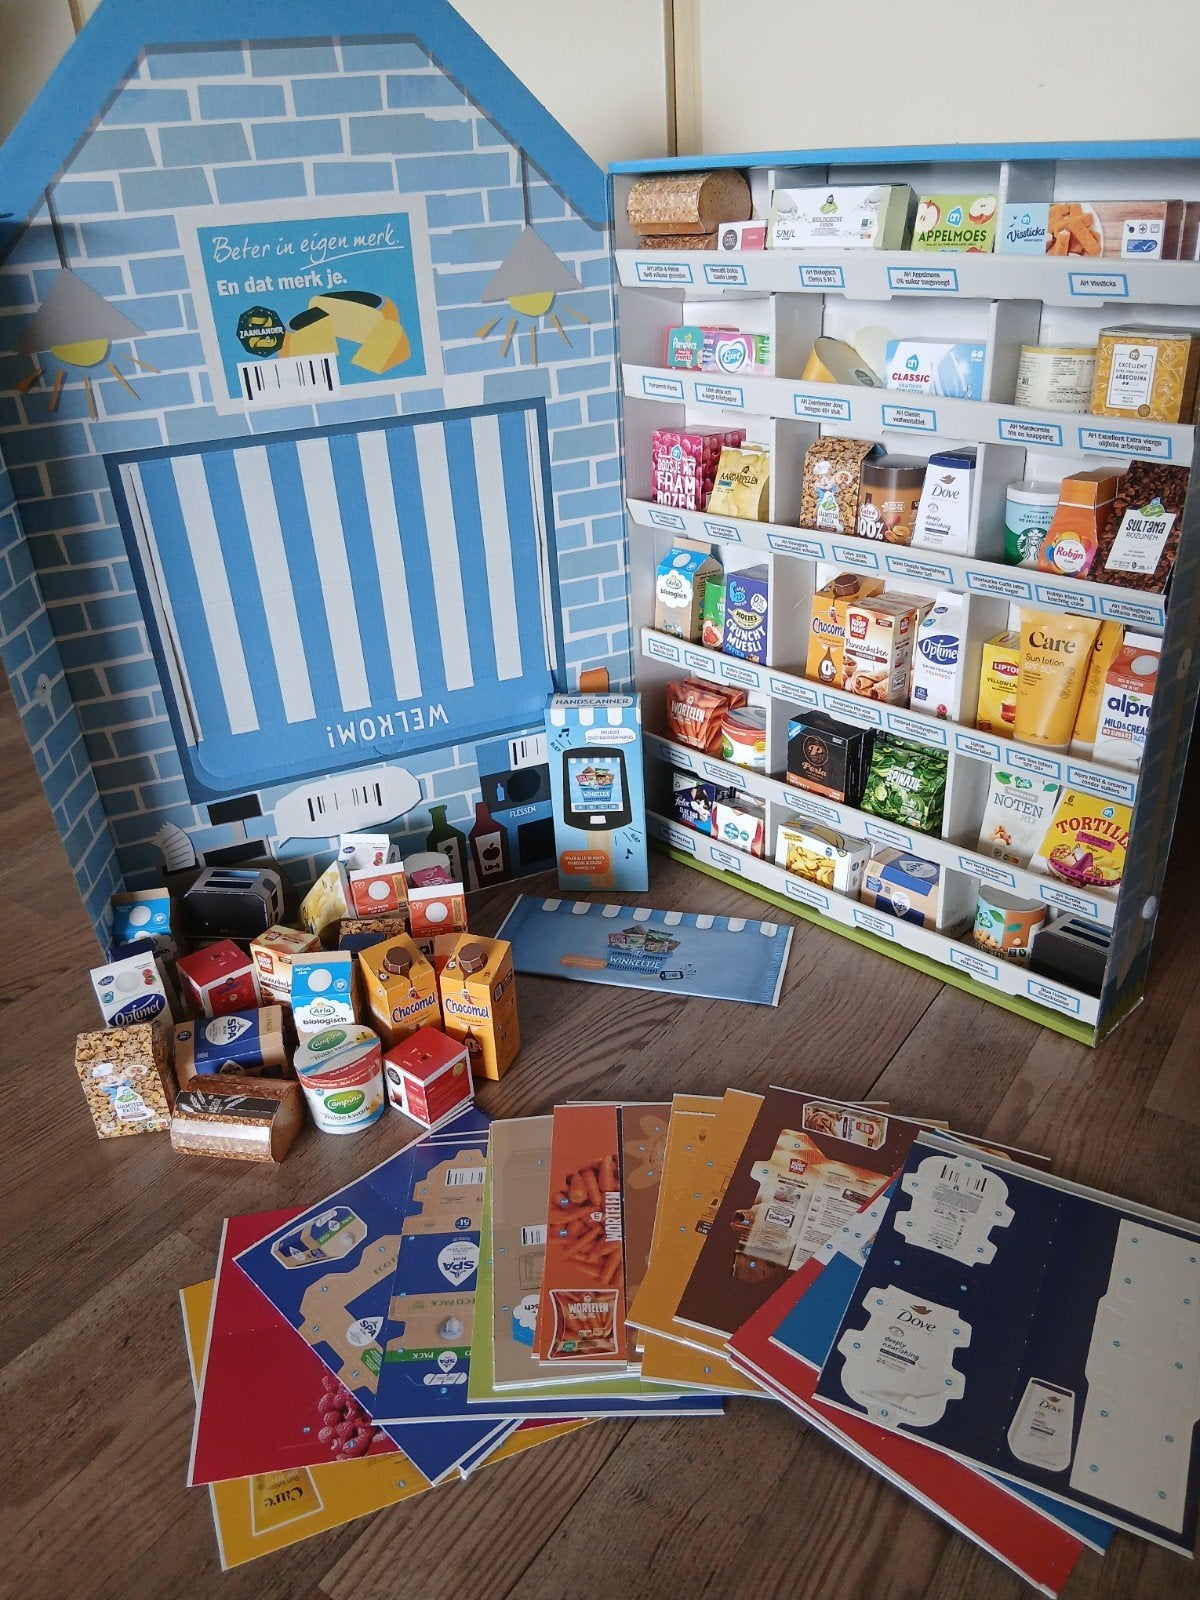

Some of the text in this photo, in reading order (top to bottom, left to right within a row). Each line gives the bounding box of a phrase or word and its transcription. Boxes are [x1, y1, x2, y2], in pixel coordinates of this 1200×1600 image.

[918, 229, 987, 242] APPELMOES
[1007, 227, 1046, 243] Vissticks
[212, 223, 399, 264] Beter in eigen merk.
[217, 268, 348, 296] En dat merk je.
[912, 271, 940, 279] Appelmoes
[1091, 280, 1117, 288] Vissticks
[239, 326, 284, 338] ZAANLANDER
[970, 350, 984, 358] 60
[1118, 361, 1148, 369] EXCELLENT
[892, 372, 930, 383] CLASSIC
[904, 410, 921, 418] Classic
[1098, 433, 1125, 442] Excellent
[1125, 436, 1142, 444] Extra
[1142, 438, 1162, 447] vierge
[1098, 441, 1152, 452] olijfolie arbequina
[657, 459, 681, 474] DOOSJE
[657, 471, 696, 496] FRAM
[719, 472, 759, 485] AARDAPPELEN
[931, 484, 960, 500] Dove
[656, 491, 696, 511] BOZEN
[925, 513, 942, 523] deeply
[924, 520, 952, 532] nourishing
[1056, 546, 1084, 560] Robijn
[660, 587, 688, 600] biologisch
[1046, 590, 1062, 599] Robijn
[1070, 600, 1085, 608] color
[1108, 607, 1129, 617] Sultana
[726, 619, 767, 641] CRUNCHY
[812, 617, 846, 638] Chocome
[726, 633, 763, 653] MUESLI
[1029, 630, 1076, 654] Care
[922, 639, 958, 661] Optime
[1023, 662, 1039, 671] SPF
[1025, 653, 1065, 667] Sun lotion
[986, 677, 1007, 687] YELLOW
[671, 700, 706, 723] WORTELEN
[327, 703, 450, 749] WELKOM!
[1110, 730, 1132, 740] SUGARS
[1014, 753, 1026, 761] Care
[1022, 761, 1033, 769] SPF
[886, 769, 922, 793] SPINAZIE
[1073, 771, 1088, 780] Alpro
[1088, 774, 1101, 782] Mild
[1106, 779, 1128, 791] creamy
[1081, 778, 1120, 795] zonder suikers
[993, 792, 1044, 819] NOTEN
[1067, 795, 1075, 803] 6
[509, 805, 536, 818] FLESSEN
[1020, 814, 1037, 826] MIX
[609, 956, 662, 969] WINKELTJE
[114, 1000, 161, 1027] Optimel
[392, 992, 437, 1024] Chocomel
[445, 998, 490, 1019] Chocomel
[303, 1017, 347, 1026] biologisch
[226, 1018, 237, 1040] SPA
[311, 1031, 343, 1050] Campina
[314, 1041, 355, 1061] milde kwark
[116, 1101, 144, 1110] HAMSTER
[327, 1093, 362, 1110] Campina
[325, 1105, 371, 1121] milde kwark
[605, 1191, 622, 1243] WORTELEN
[373, 1261, 391, 1276] ECO
[444, 1260, 475, 1272] SPA
[430, 1297, 476, 1308] ECO PACK
[568, 1302, 609, 1313] WORTELEN
[896, 1309, 936, 1333] Dove
[359, 1319, 378, 1338] SPA
[884, 1335, 907, 1349] deeply
[412, 1352, 435, 1360] PACK
[882, 1342, 920, 1362] nourishing
[439, 1358, 456, 1366] SPA
[876, 1357, 886, 1365] 24
[1039, 1399, 1065, 1414] Dove
[264, 1486, 304, 1508] Care
